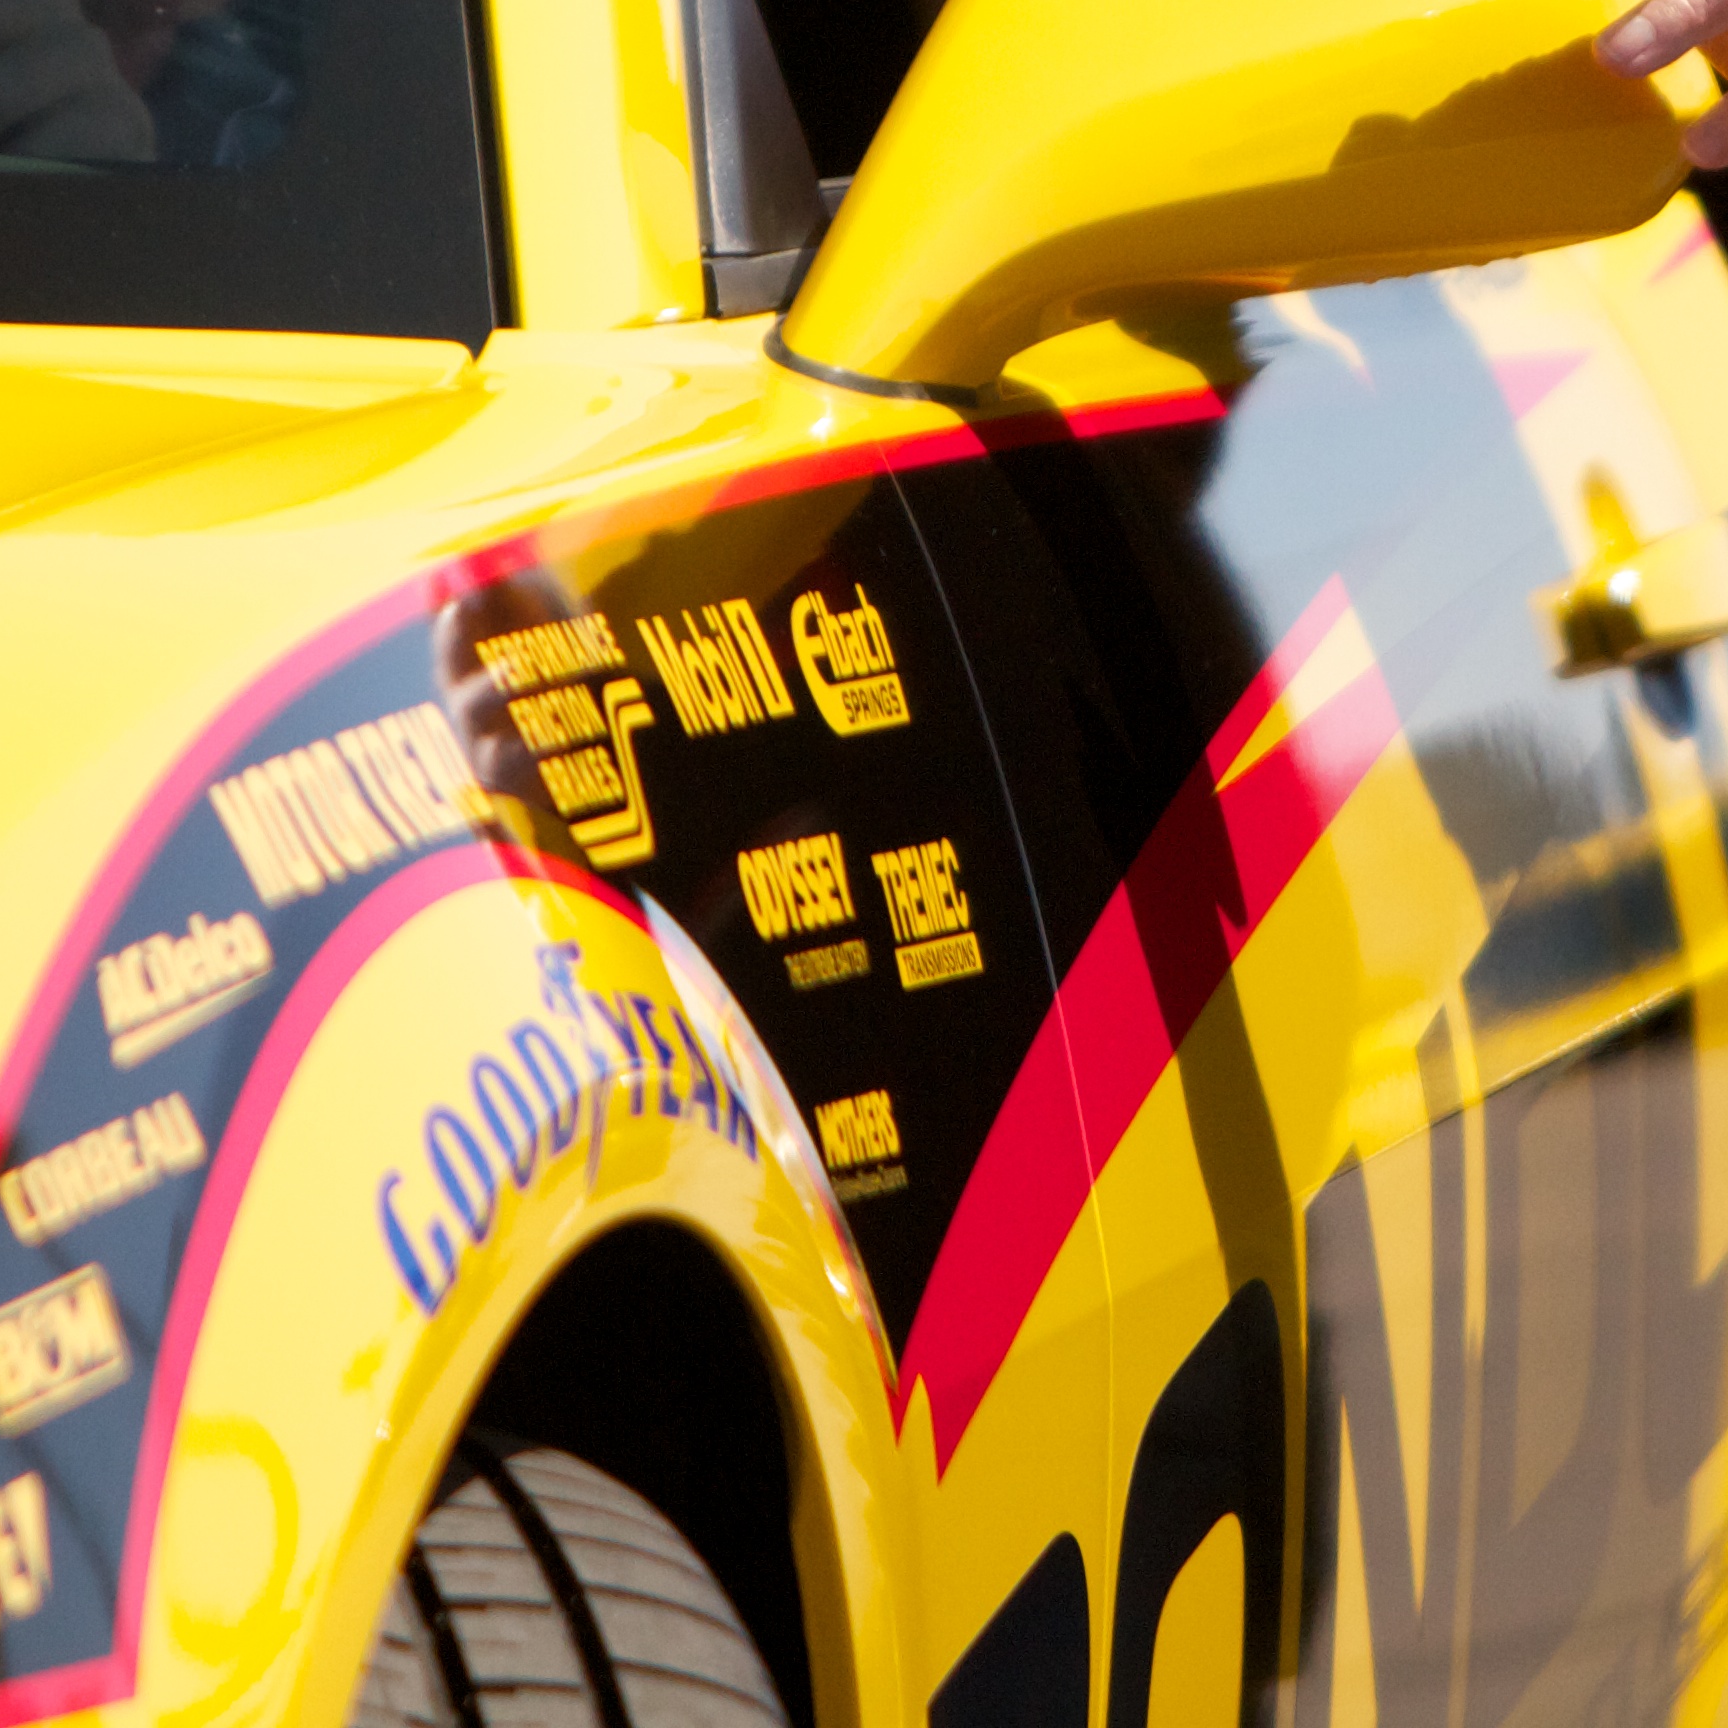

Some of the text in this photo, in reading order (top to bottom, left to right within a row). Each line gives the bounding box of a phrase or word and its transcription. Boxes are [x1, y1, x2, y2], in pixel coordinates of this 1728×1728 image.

[475, 611, 626, 694] PERFORMANCE
[790, 582, 897, 687] Eibach
[508, 682, 610, 753] FRICTION
[840, 678, 904, 726] SPRINGS
[208, 700, 496, 910] MOTOR TREND
[536, 744, 625, 819] BRAKES
[736, 831, 858, 943] ODYSSEY
[871, 836, 970, 943] TREMEC
[95, 909, 274, 1038] ACDelco
[901, 936, 978, 981] TRANSMISSIONS
[377, 984, 760, 1319] GOODYEAR
